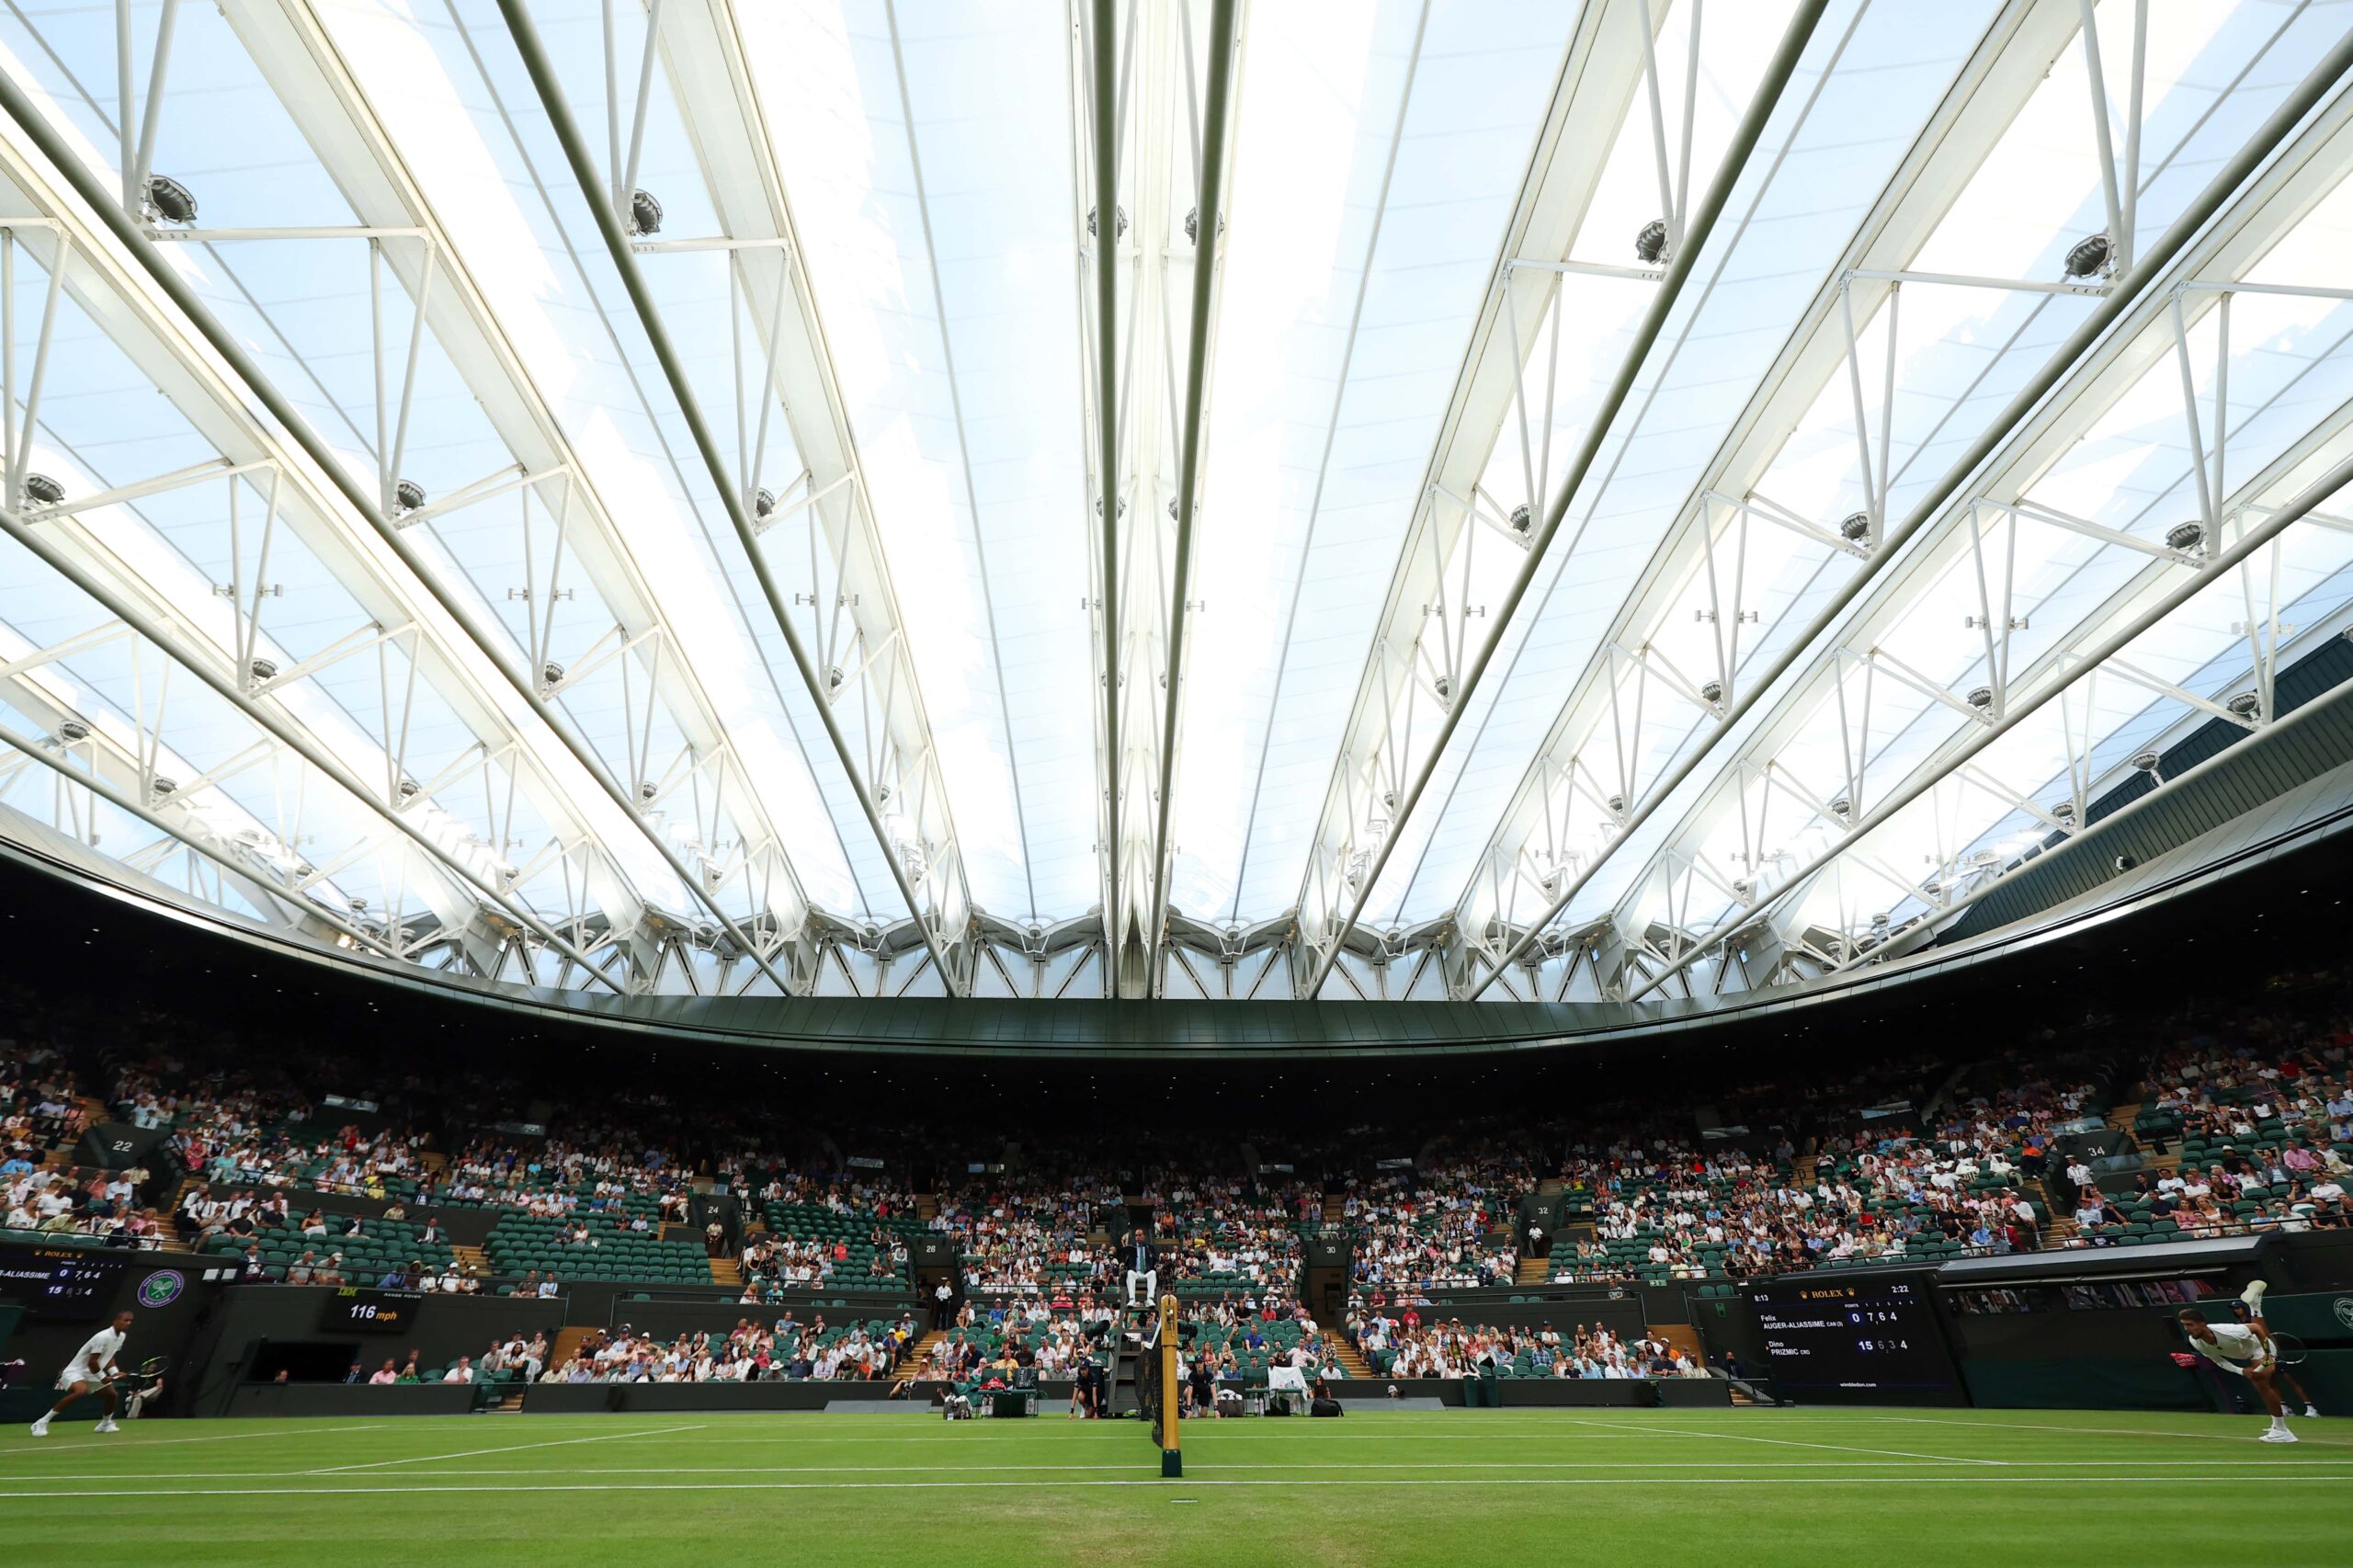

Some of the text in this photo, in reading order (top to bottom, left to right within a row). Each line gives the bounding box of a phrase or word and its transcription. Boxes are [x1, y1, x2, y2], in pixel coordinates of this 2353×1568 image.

[112, 1141, 132, 1152] 22
[2087, 1145, 2106, 1157] 34
[707, 1205, 719, 1214] 24
[1538, 1206, 1549, 1215] 32
[44, 1250, 74, 1258] ROLEX
[1326, 1245, 1336, 1254] 30
[59, 1269, 69, 1278] 0
[75, 1270, 84, 1278] 7
[93, 1271, 101, 1279] 4
[48, 1286, 63, 1294] 15
[84, 1288, 93, 1296] 4
[337, 1286, 359, 1297] IBM
[1812, 1290, 1844, 1299] ROLEX
[1891, 1285, 1910, 1293] 2:22
[350, 1304, 397, 1322] 116 mph
[1763, 1321, 1826, 1330] AUGER-ALIASSIME
[1851, 1312, 1860, 1323] 0
[1867, 1312, 1873, 1322] 7
[1878, 1312, 1886, 1321] 6
[1890, 1312, 1898, 1321] 4
[1859, 1340, 1874, 1351] 15
[1877, 1340, 1885, 1349] 6
[1889, 1340, 1896, 1349] 3
[1900, 1339, 1908, 1349] 4
